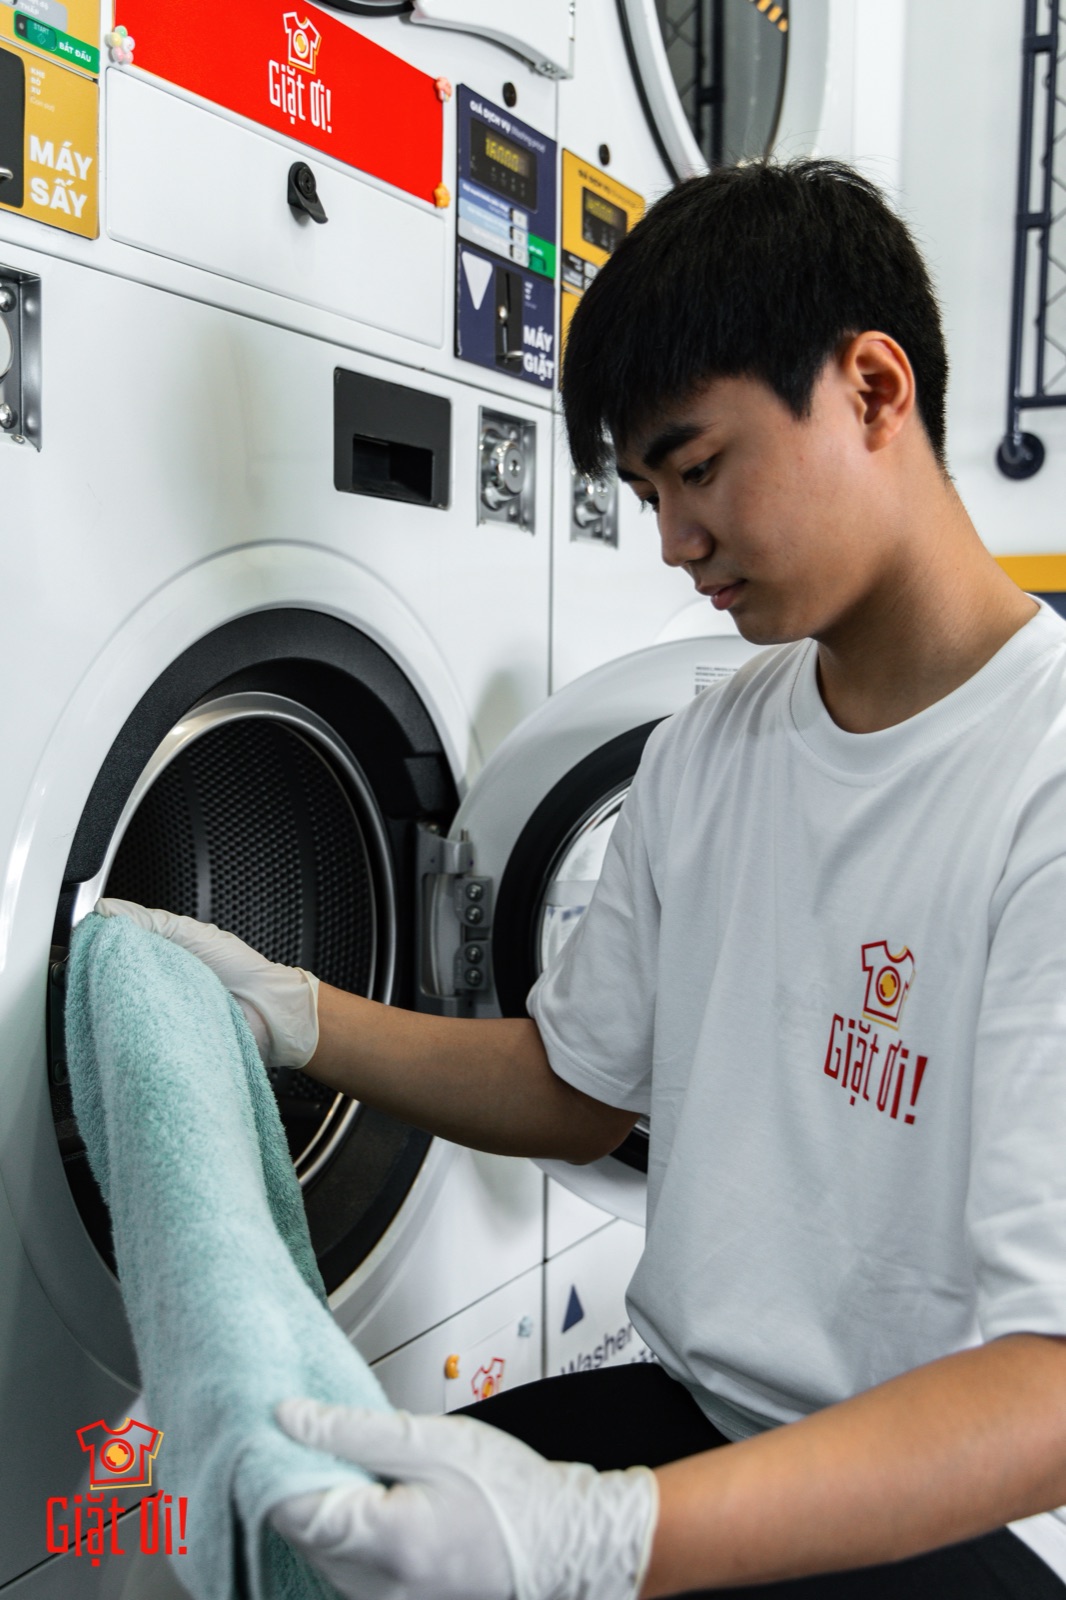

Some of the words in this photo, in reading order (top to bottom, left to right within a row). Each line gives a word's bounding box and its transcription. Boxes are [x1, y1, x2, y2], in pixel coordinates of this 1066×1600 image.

[33, 22, 50, 35] START
[268, 59, 306, 125] Giặt
[29, 134, 93, 181] MÁY
[29, 176, 88, 219] SẤY
[523, 325, 553, 353] MÁY
[523, 352, 554, 381] GIẶT
[823, 1012, 879, 1107] Giặt
